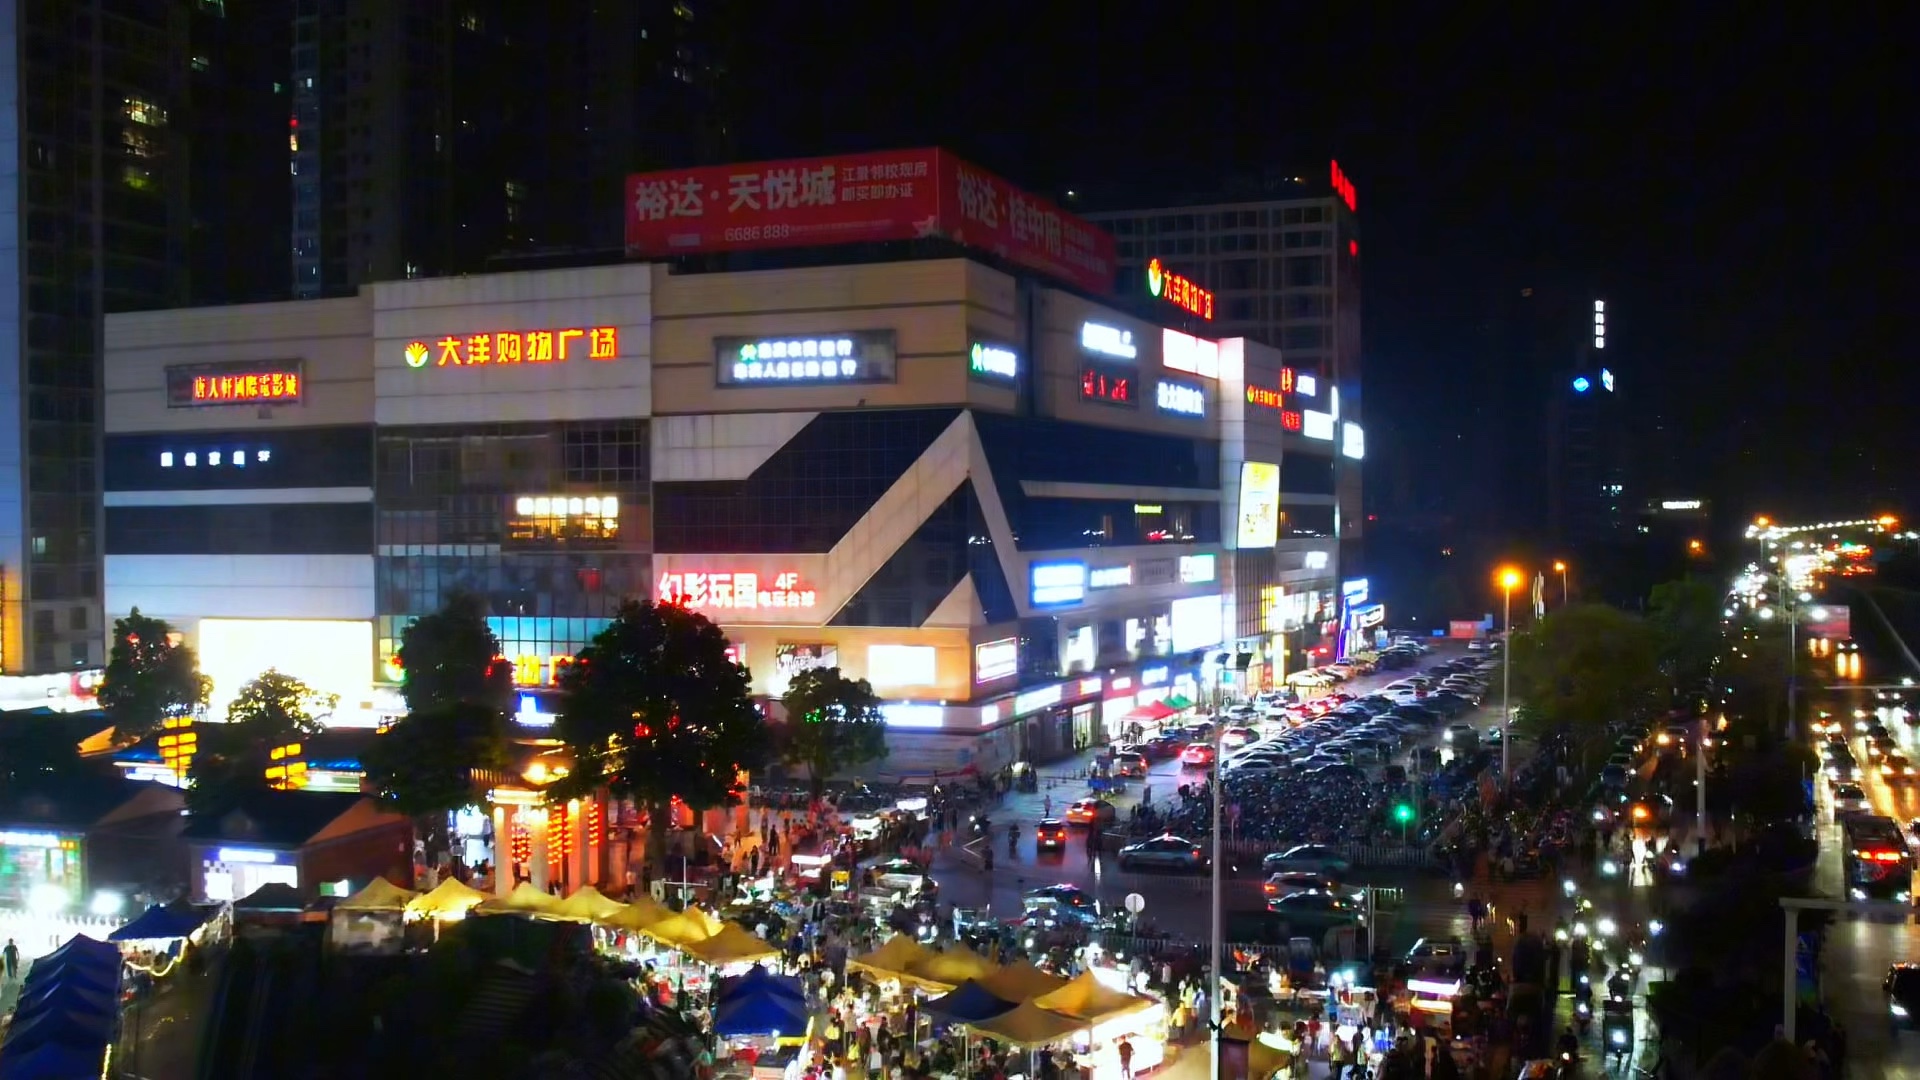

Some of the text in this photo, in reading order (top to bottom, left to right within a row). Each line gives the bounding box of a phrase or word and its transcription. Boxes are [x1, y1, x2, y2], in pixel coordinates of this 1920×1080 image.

[1163, 270, 1212, 320] 大洋购物广场
[437, 328, 616, 366] 大洋购物广场
[775, 573, 798, 589] 4F
